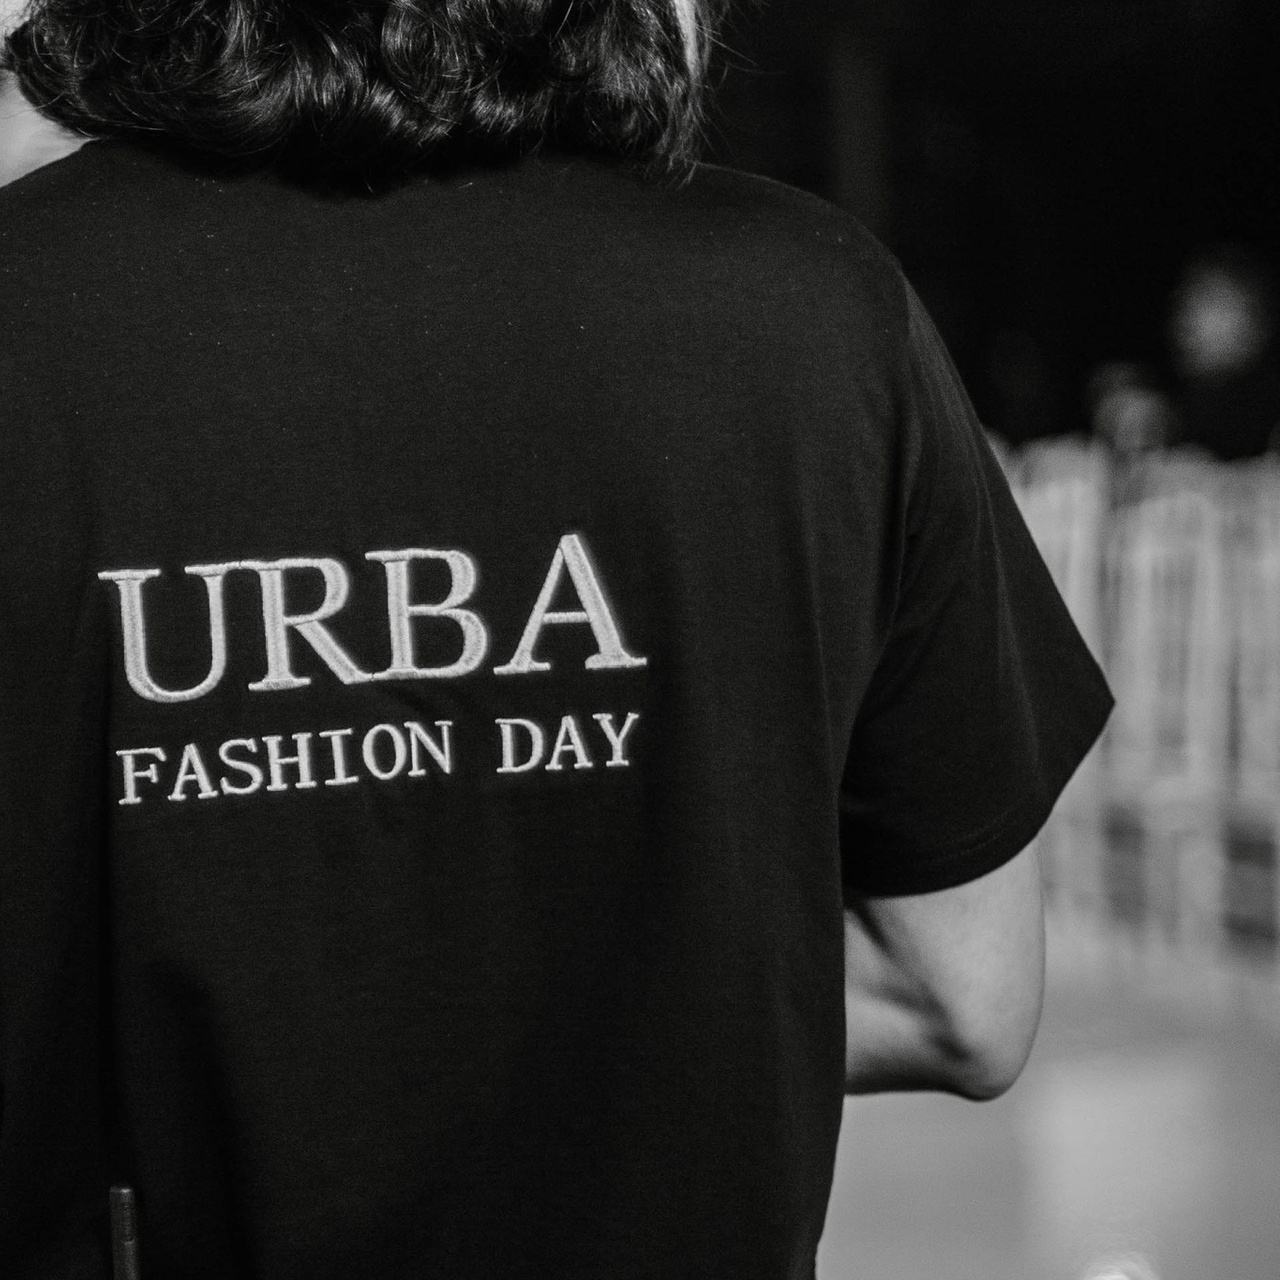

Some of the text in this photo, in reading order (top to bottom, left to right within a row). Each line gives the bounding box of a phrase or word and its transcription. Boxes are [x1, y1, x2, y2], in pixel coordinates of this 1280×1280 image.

[97, 533, 648, 703] URBA
[115, 711, 640, 806] FASHION DAY
